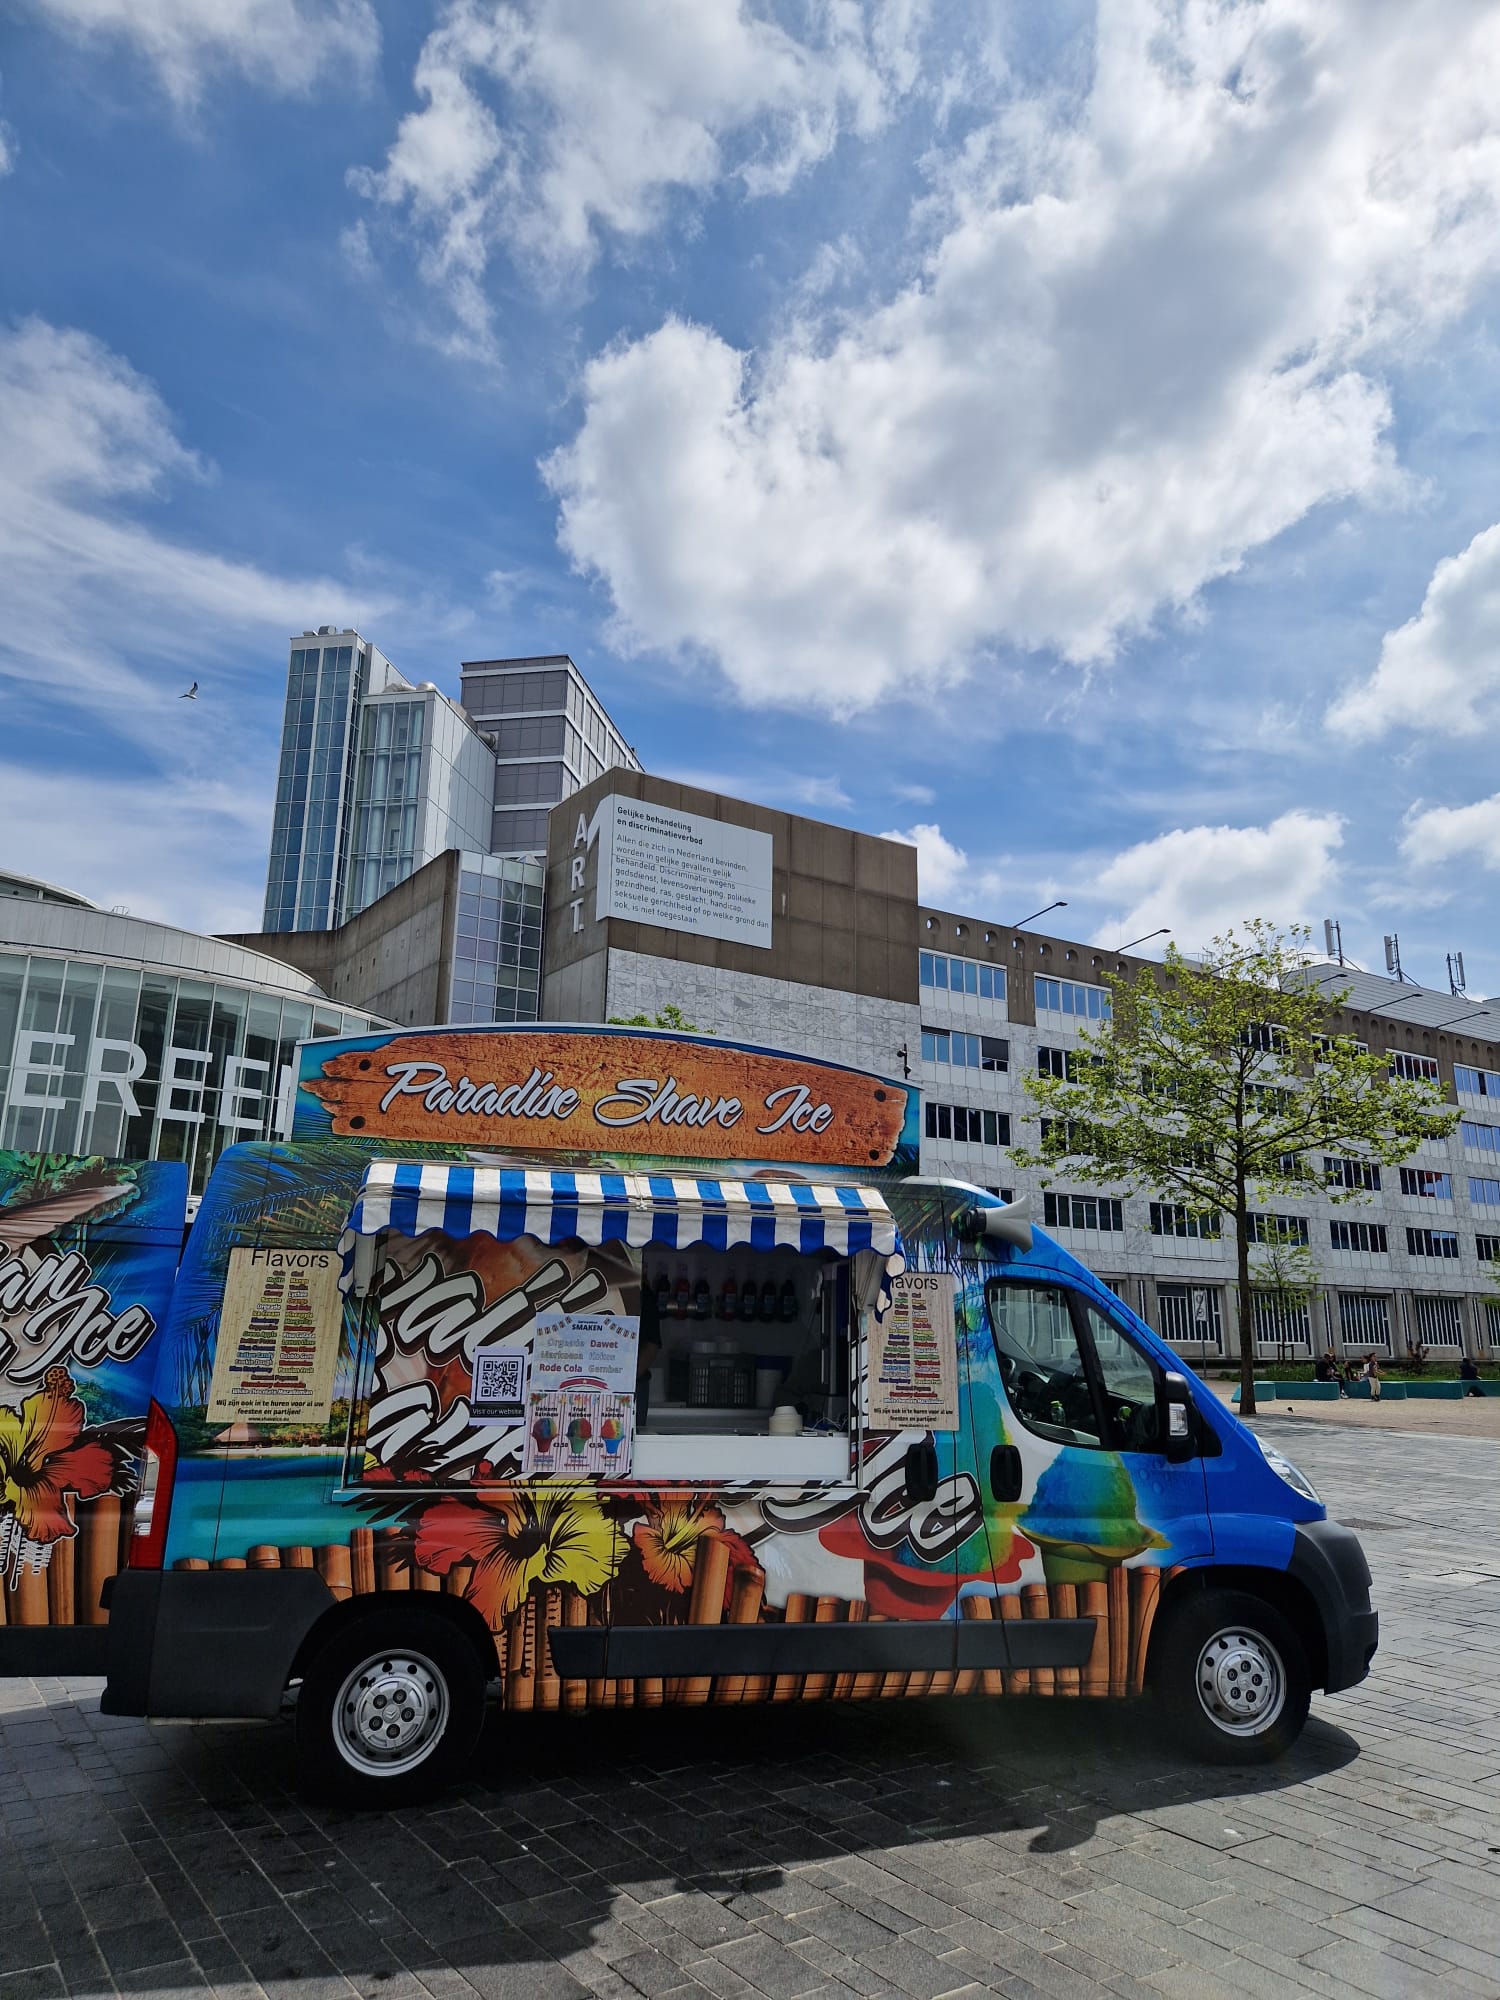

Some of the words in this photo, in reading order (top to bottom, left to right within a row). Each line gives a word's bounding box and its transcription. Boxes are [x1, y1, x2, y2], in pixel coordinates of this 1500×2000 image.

[616, 818, 627, 826] en
[628, 820, 703, 845] discriminatieverbod
[617, 806, 645, 819] Gelijke
[645, 813, 692, 833] behandeling
[616, 834, 637, 845] Allen
[638, 840, 650, 849] die
[651, 843, 666, 852] zich
[676, 848, 714, 864] Nederland
[715, 858, 749, 872] bevinden,
[616, 846, 645, 858] worden
[646, 852, 654, 861] in
[655, 855, 680, 867] gelijke
[681, 861, 711, 873] gevallen
[712, 869, 732, 879] gelijk
[615, 868, 659, 884] godsdienst,
[660, 876, 726, 900] levensovertuiging,
[727, 892, 756, 905] politieke
[659, 865, 708, 883] Discriminatie
[708, 878, 736, 890] wegens
[614, 890, 649, 903] seksuele
[650, 897, 692, 912] gerichtheid
[702, 909, 711, 917] op
[712, 911, 734, 921] welke
[735, 916, 755, 926] grond
[756, 920, 769, 929] dan
[615, 879, 658, 895] gezindheid,
[659, 889, 674, 898] ras,
[675, 892, 709, 906] geslacht,
[710, 898, 744, 913] handicap,
[640, 907, 655, 915] niet
[379, 1060, 580, 1120] Paradise
[594, 1074, 744, 1129] Shave
[756, 1083, 834, 1135] Ice
[251, 1248, 329, 1269] Flavors
[6, 1286, 151, 1380] Ice
[589, 1339, 619, 1349] Dawet
[539, 1364, 562, 1372] Rode
[563, 1364, 583, 1373] Cola
[216, 1399, 227, 1408] Wij
[228, 1399, 240, 1408] zijn
[240, 1399, 253, 1407] ook
[270, 1399, 290, 1408] huren
[237, 1408, 263, 1416] feesten
